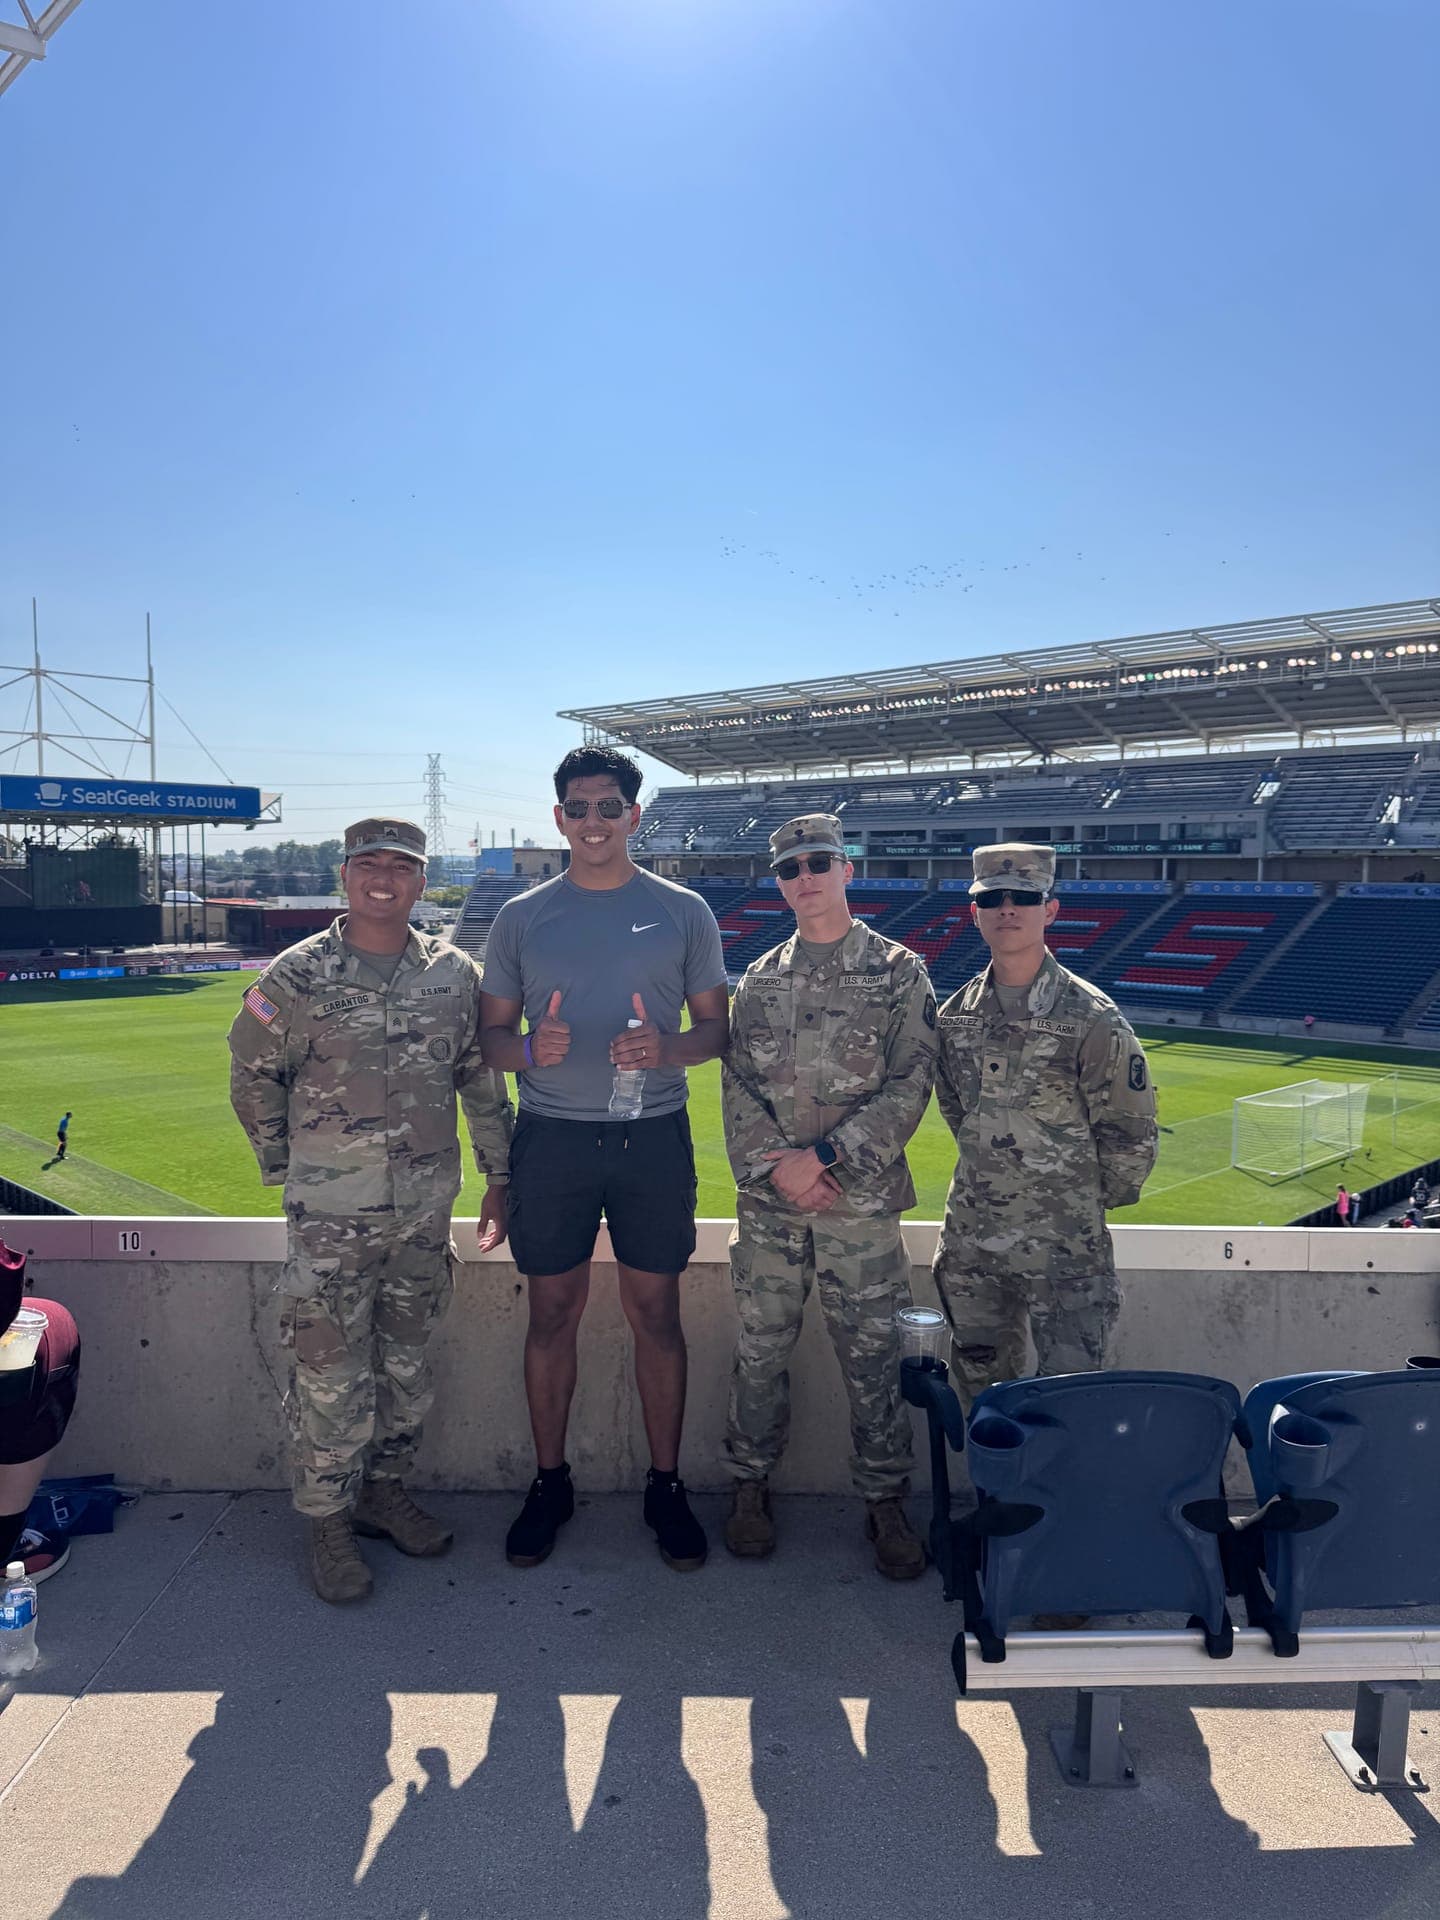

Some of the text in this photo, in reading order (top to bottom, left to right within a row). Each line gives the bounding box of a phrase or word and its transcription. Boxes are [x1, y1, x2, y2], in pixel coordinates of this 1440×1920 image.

[72, 786, 237, 809] SeatGeek STADIUM
[20, 970, 57, 980] DELTA
[862, 976, 885, 985] ARMY
[121, 1232, 140, 1250] 10
[1224, 1241, 1233, 1259] 6
